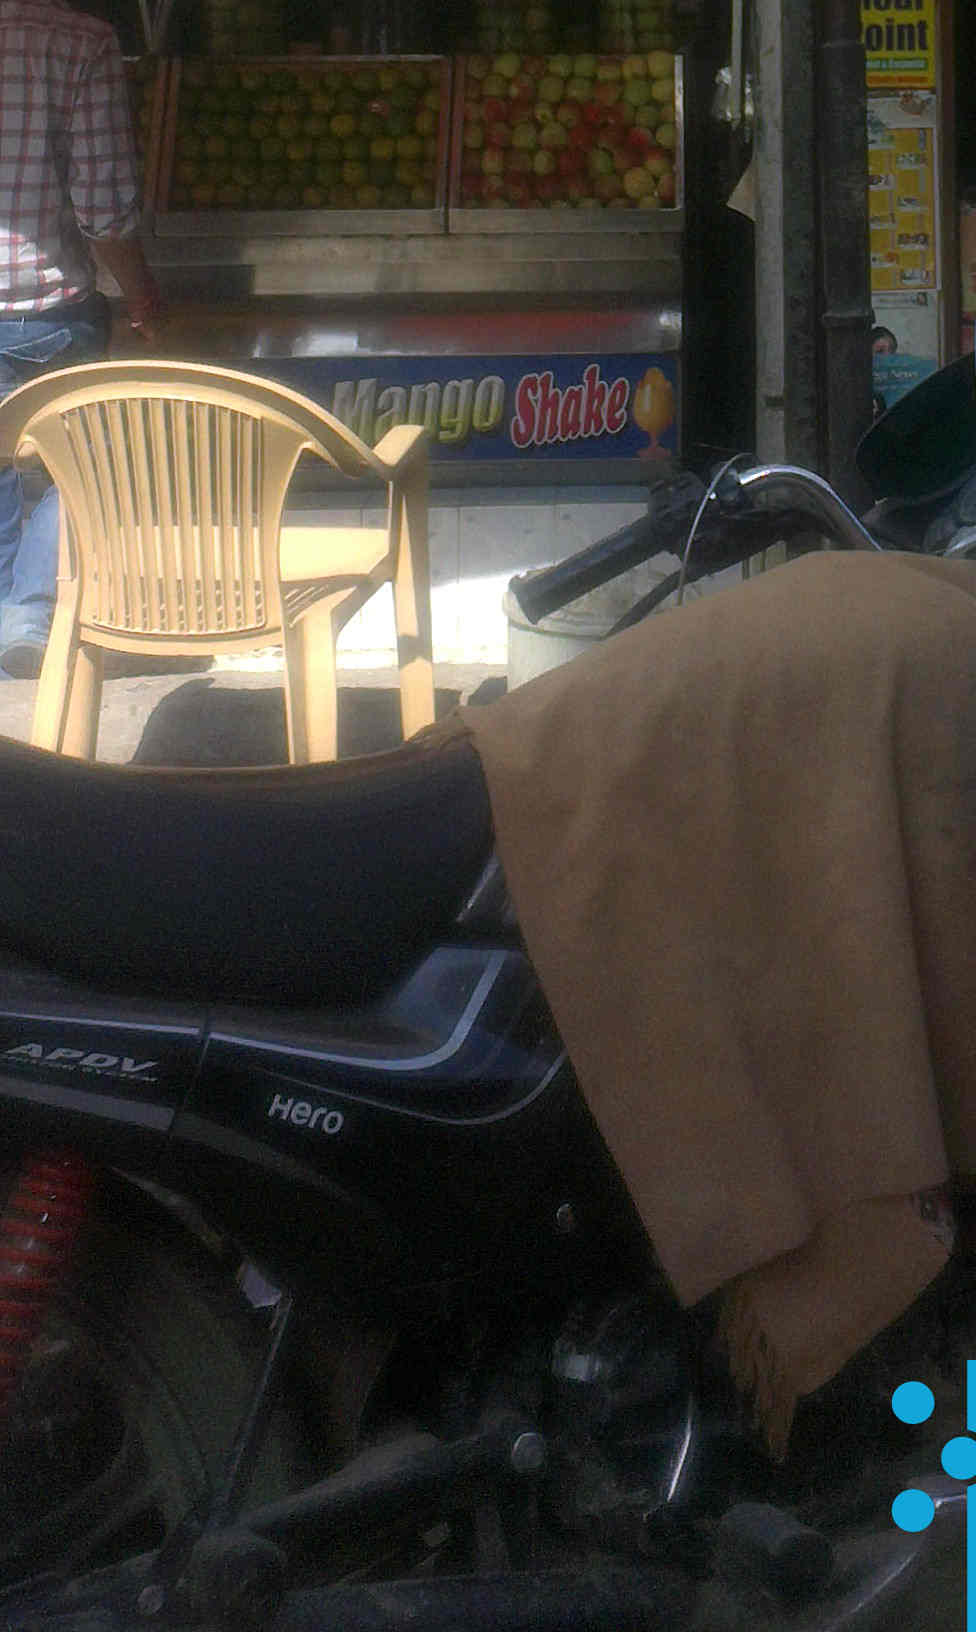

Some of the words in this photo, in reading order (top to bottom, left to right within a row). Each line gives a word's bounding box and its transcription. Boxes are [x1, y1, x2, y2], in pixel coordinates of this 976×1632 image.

[331, 375, 506, 448] Mango
[512, 363, 630, 449] Shake
[267, 1093, 345, 1135] Hero
